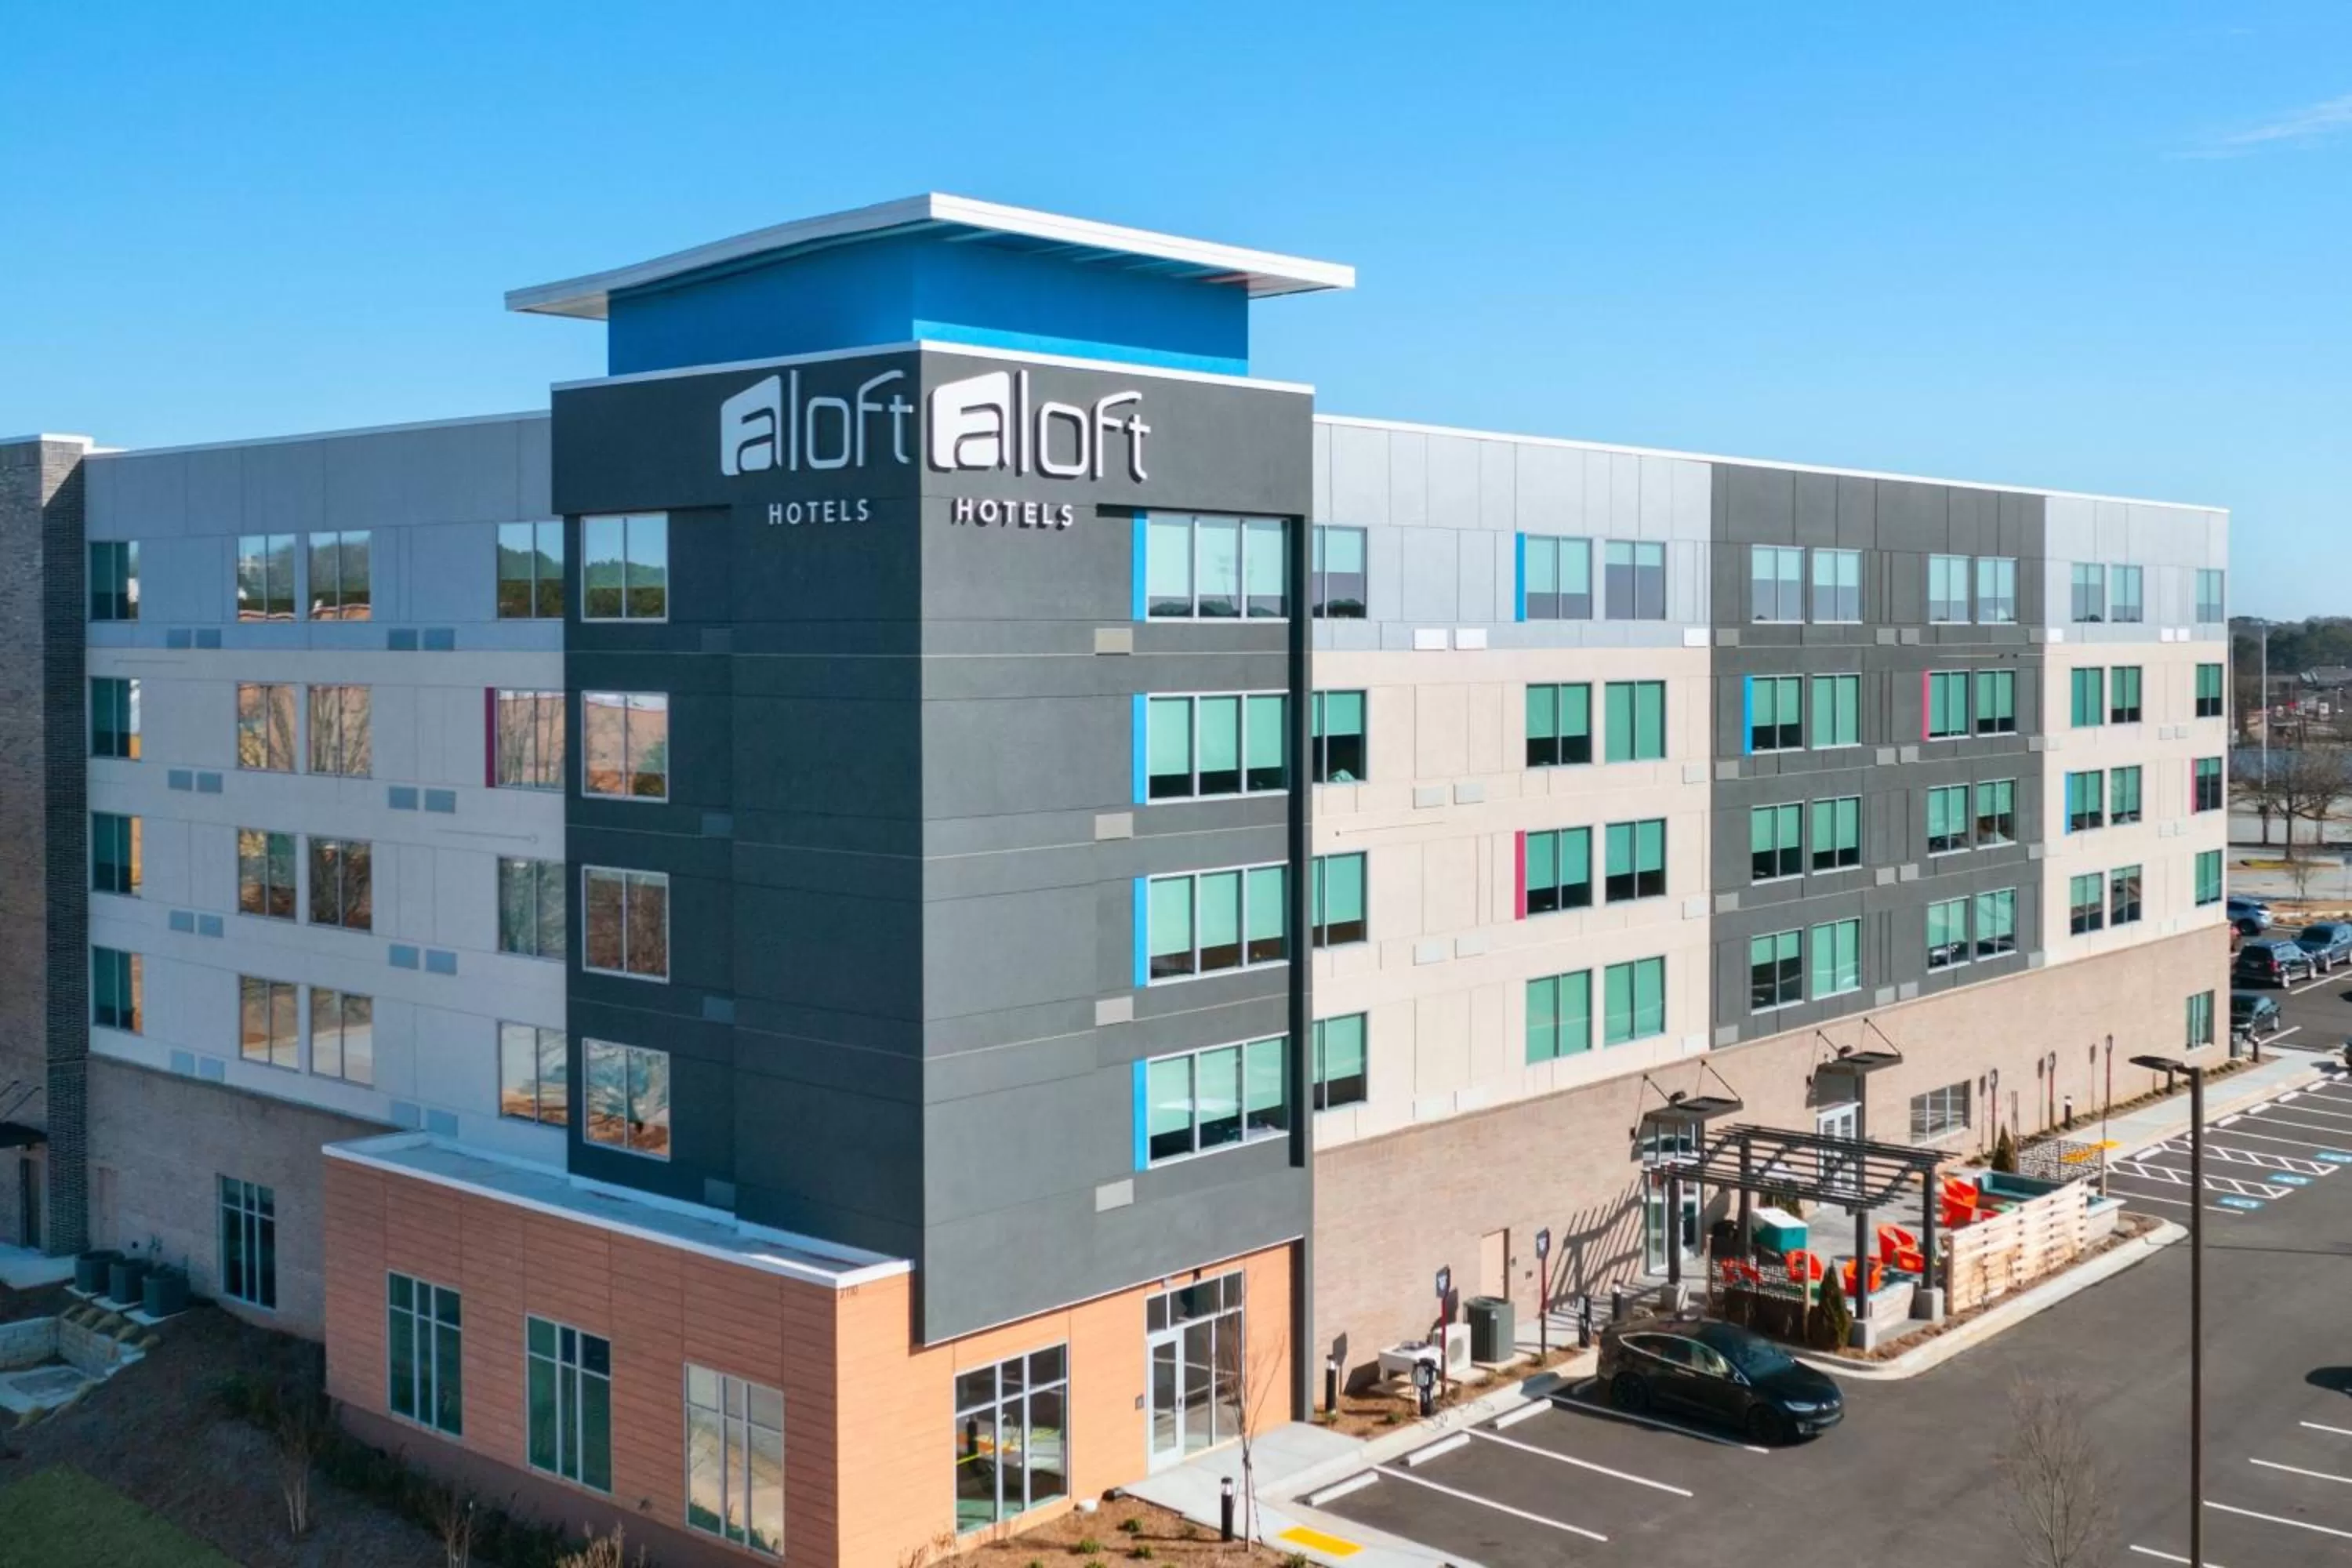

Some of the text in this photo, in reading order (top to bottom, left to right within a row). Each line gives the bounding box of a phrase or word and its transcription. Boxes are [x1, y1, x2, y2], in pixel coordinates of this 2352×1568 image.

[720, 370, 913, 475] aloft
[932, 370, 1151, 480] aloft
[768, 498, 869, 524] HOTELS
[956, 497, 1073, 526] HOTELS
